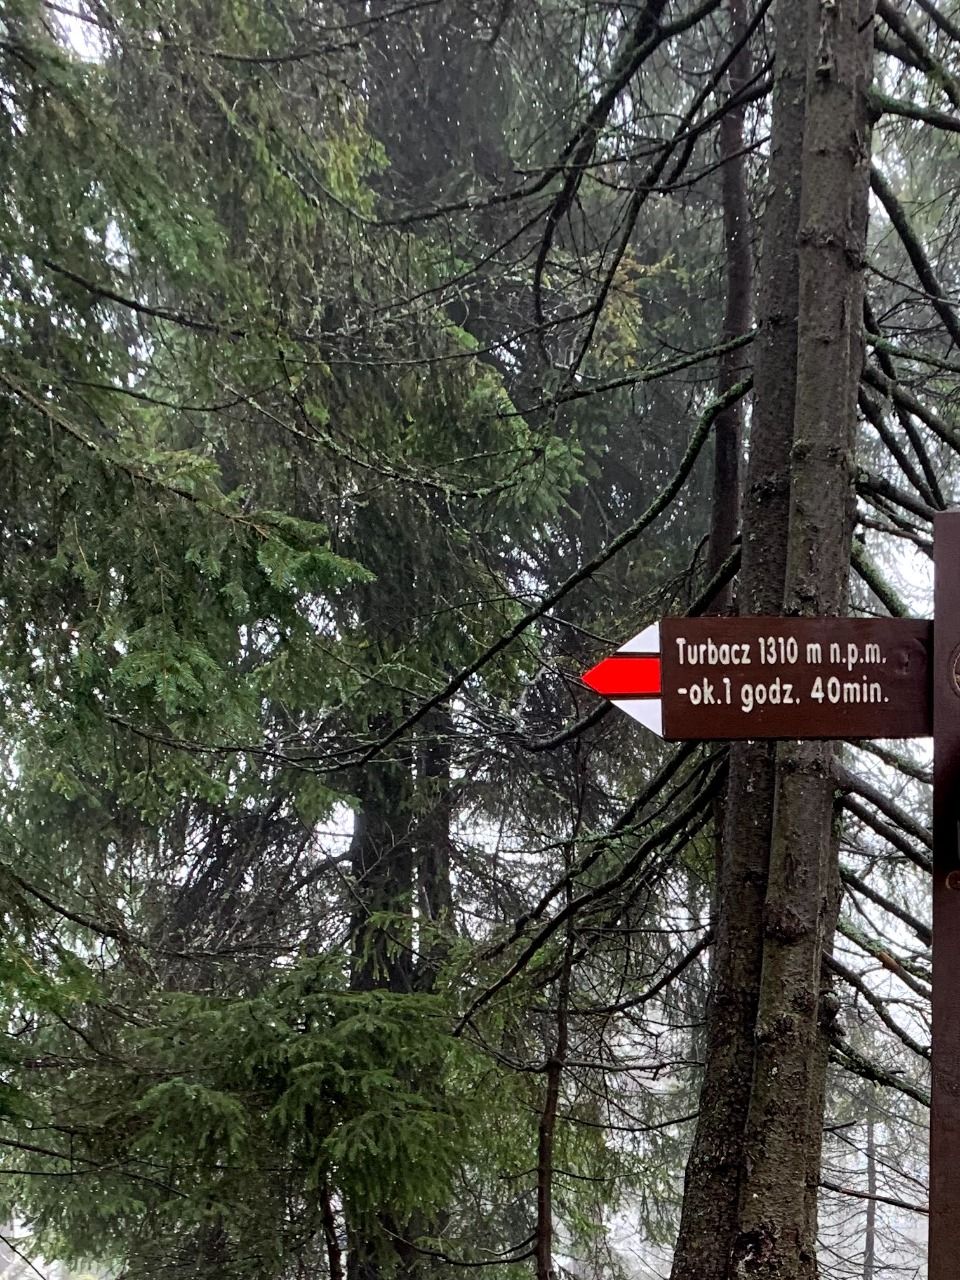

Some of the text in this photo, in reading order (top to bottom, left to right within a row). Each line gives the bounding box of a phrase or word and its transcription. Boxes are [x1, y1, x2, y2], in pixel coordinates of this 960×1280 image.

[675, 636, 887, 672] Turbacz 1310 m n.p.m.
[740, 676, 801, 713] godz.
[810, 675, 889, 704] 40min.
